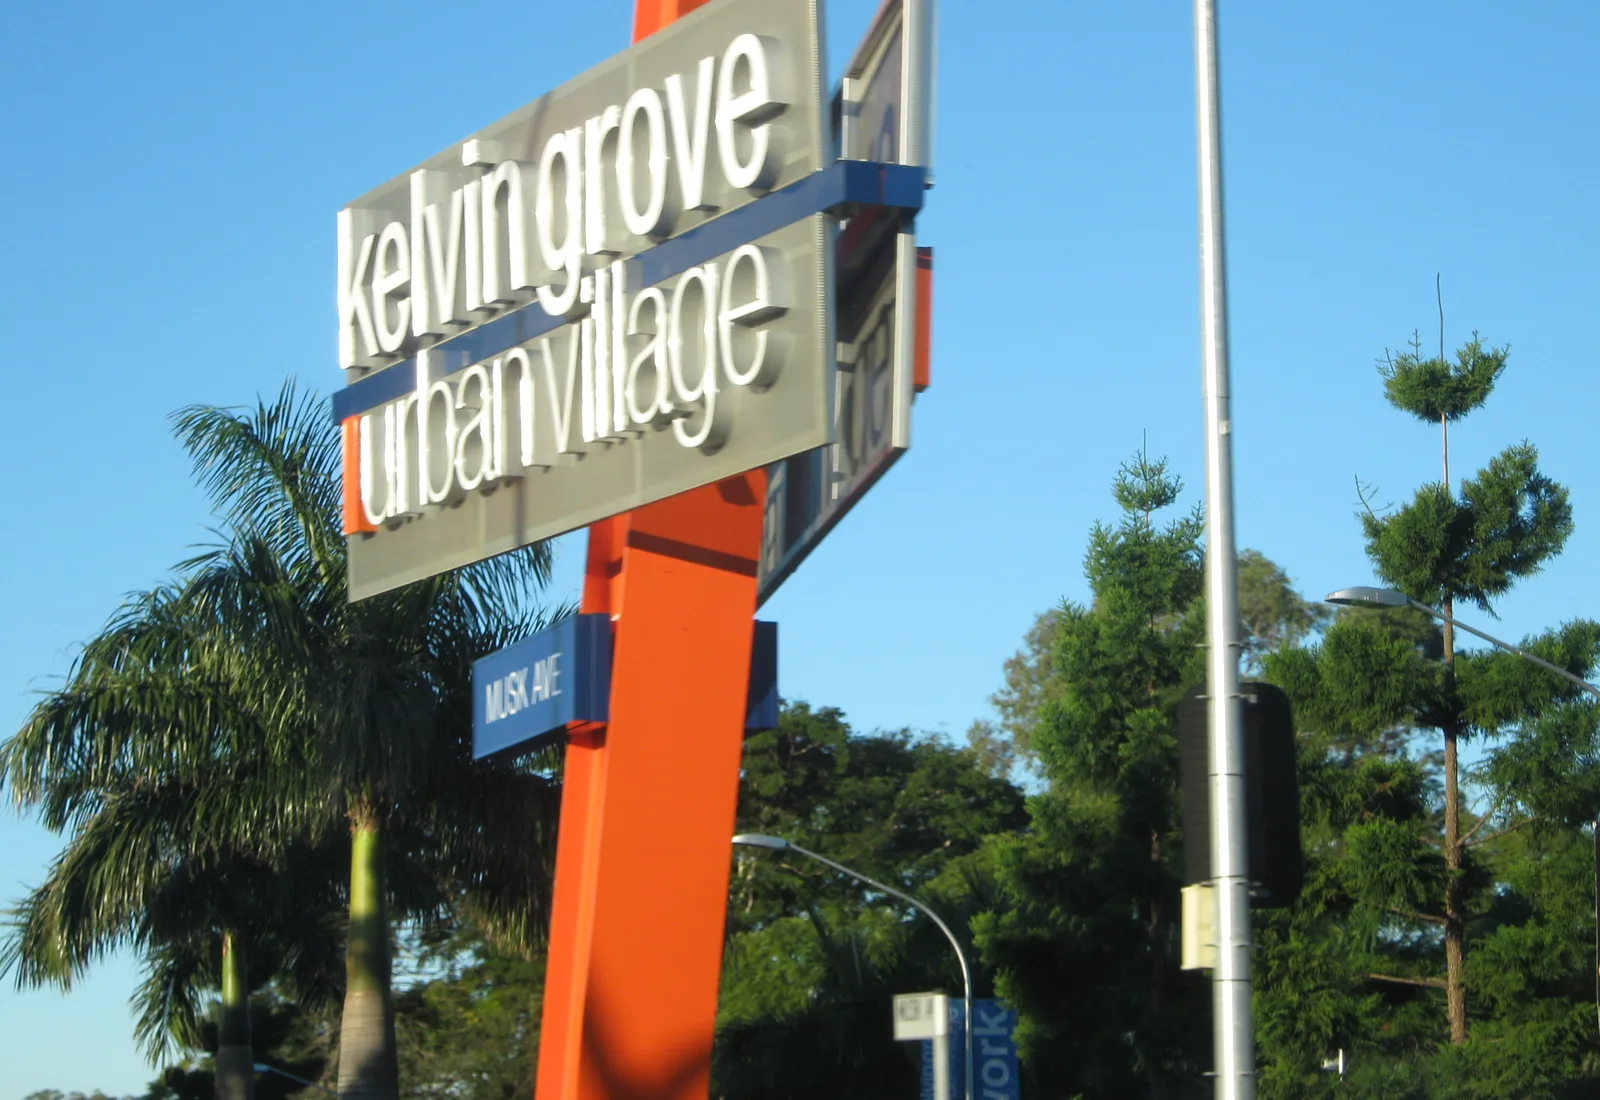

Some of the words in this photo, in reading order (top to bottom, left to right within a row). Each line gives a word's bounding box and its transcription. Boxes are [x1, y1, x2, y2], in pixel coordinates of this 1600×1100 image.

[337, 138, 530, 370] kelvin
[535, 33, 784, 316] grove
[359, 348, 538, 526] urban
[540, 243, 784, 449] village
[485, 666, 529, 724] MUSK
[530, 652, 562, 705] AVE
